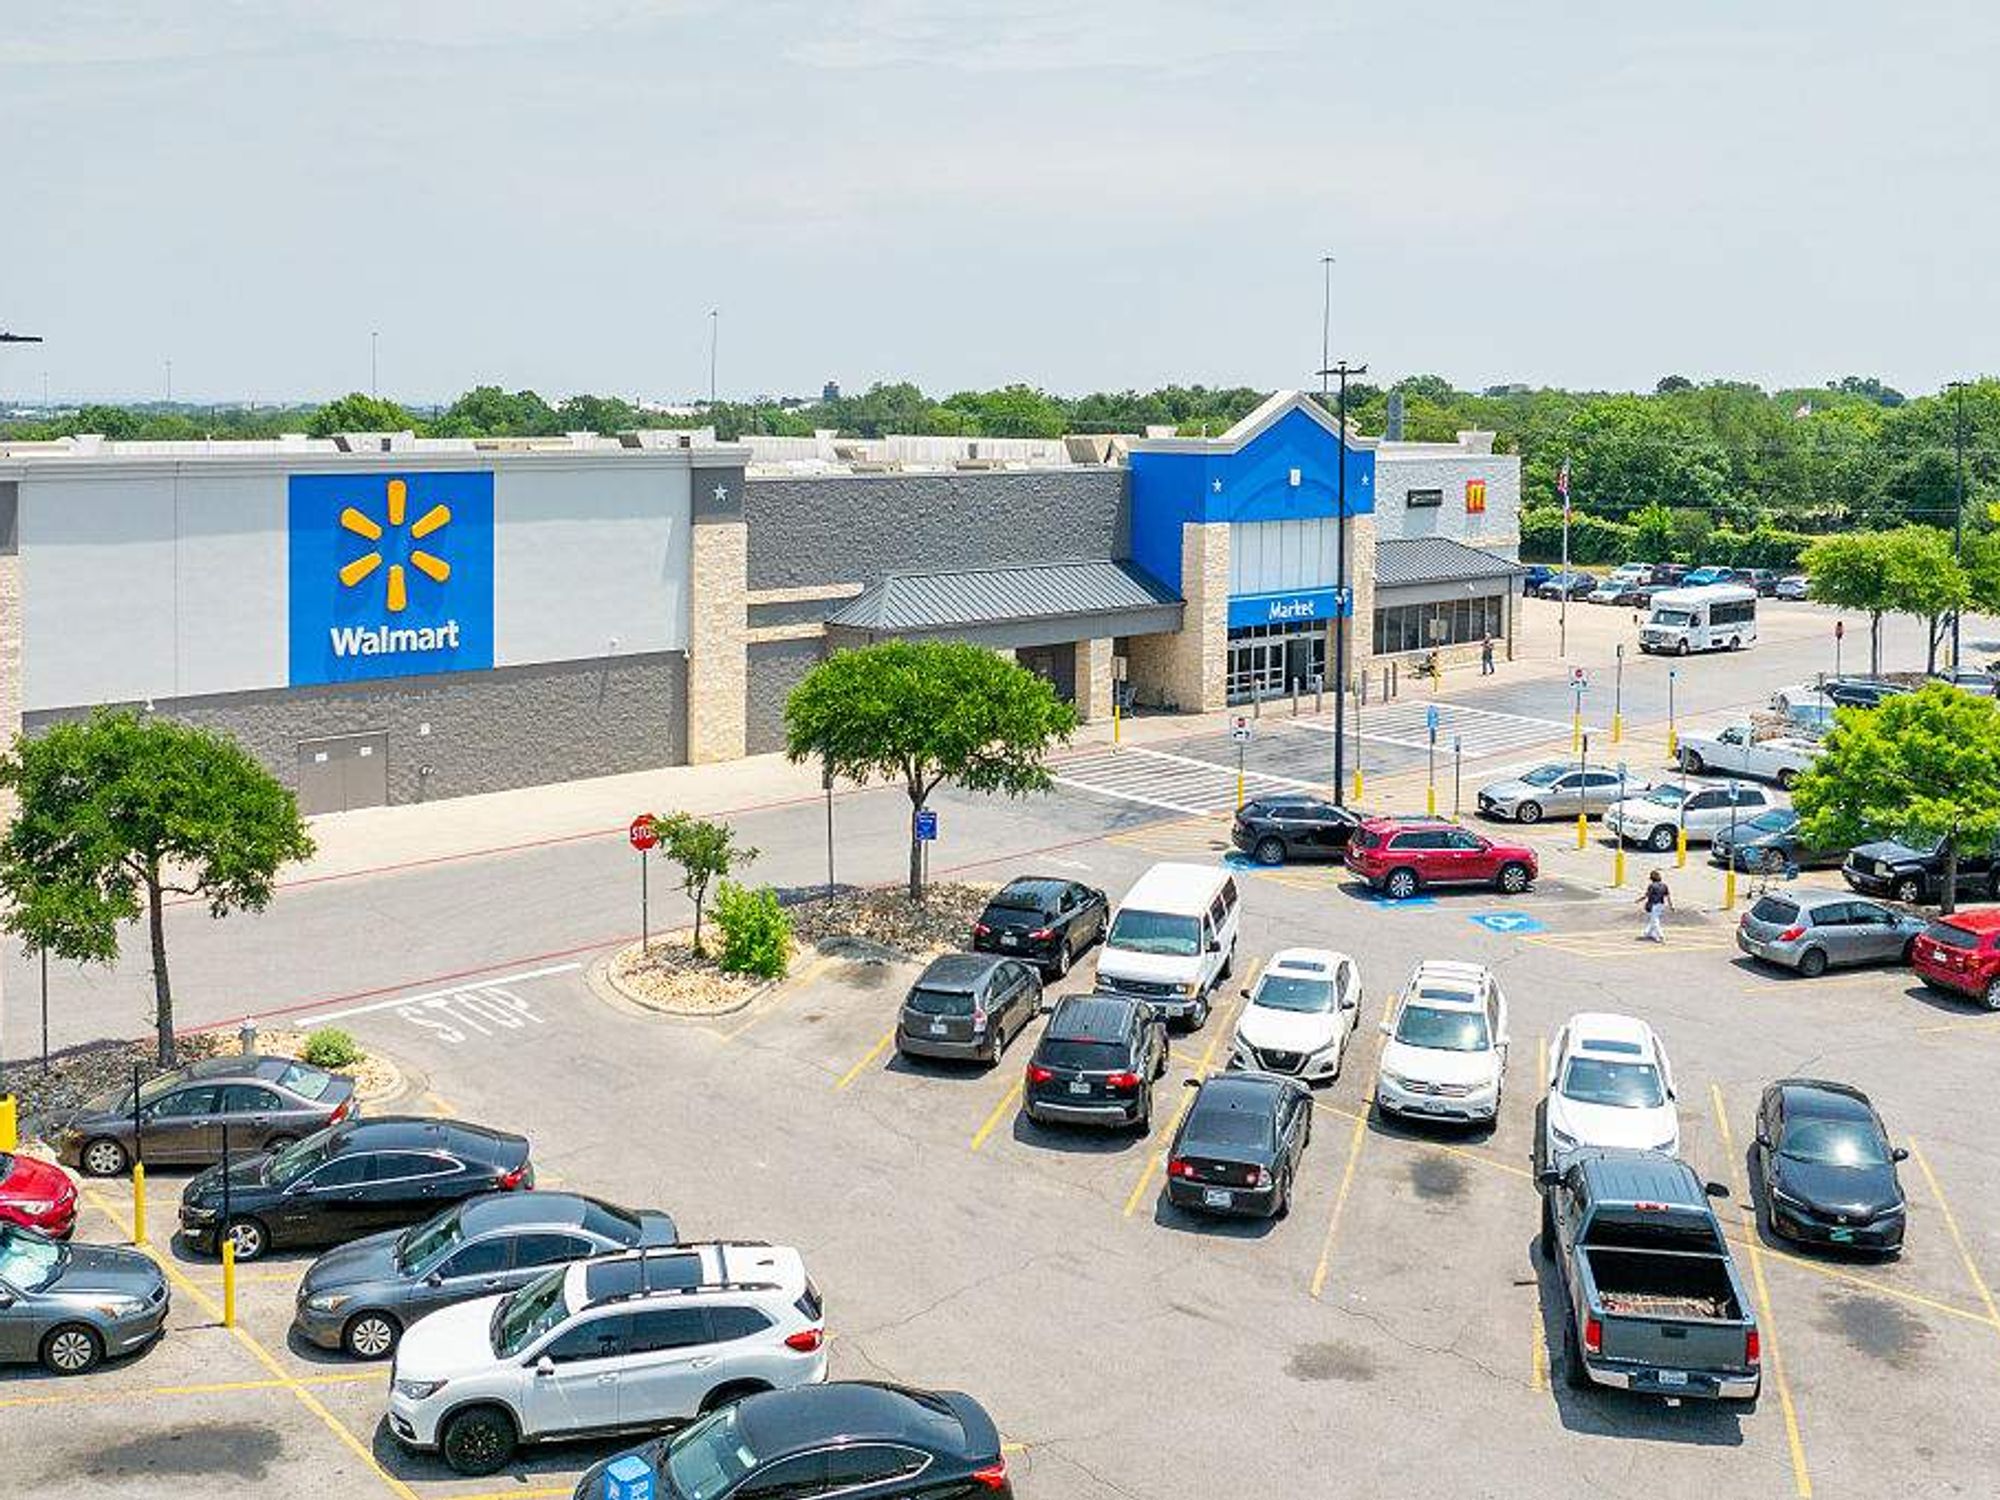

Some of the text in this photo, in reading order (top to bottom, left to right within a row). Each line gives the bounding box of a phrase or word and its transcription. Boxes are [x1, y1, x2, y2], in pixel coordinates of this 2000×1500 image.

[1268, 599, 1315, 620] Market
[330, 619, 460, 657] Walmart
[632, 825, 656, 840] STO
[397, 986, 545, 1043] STOP
